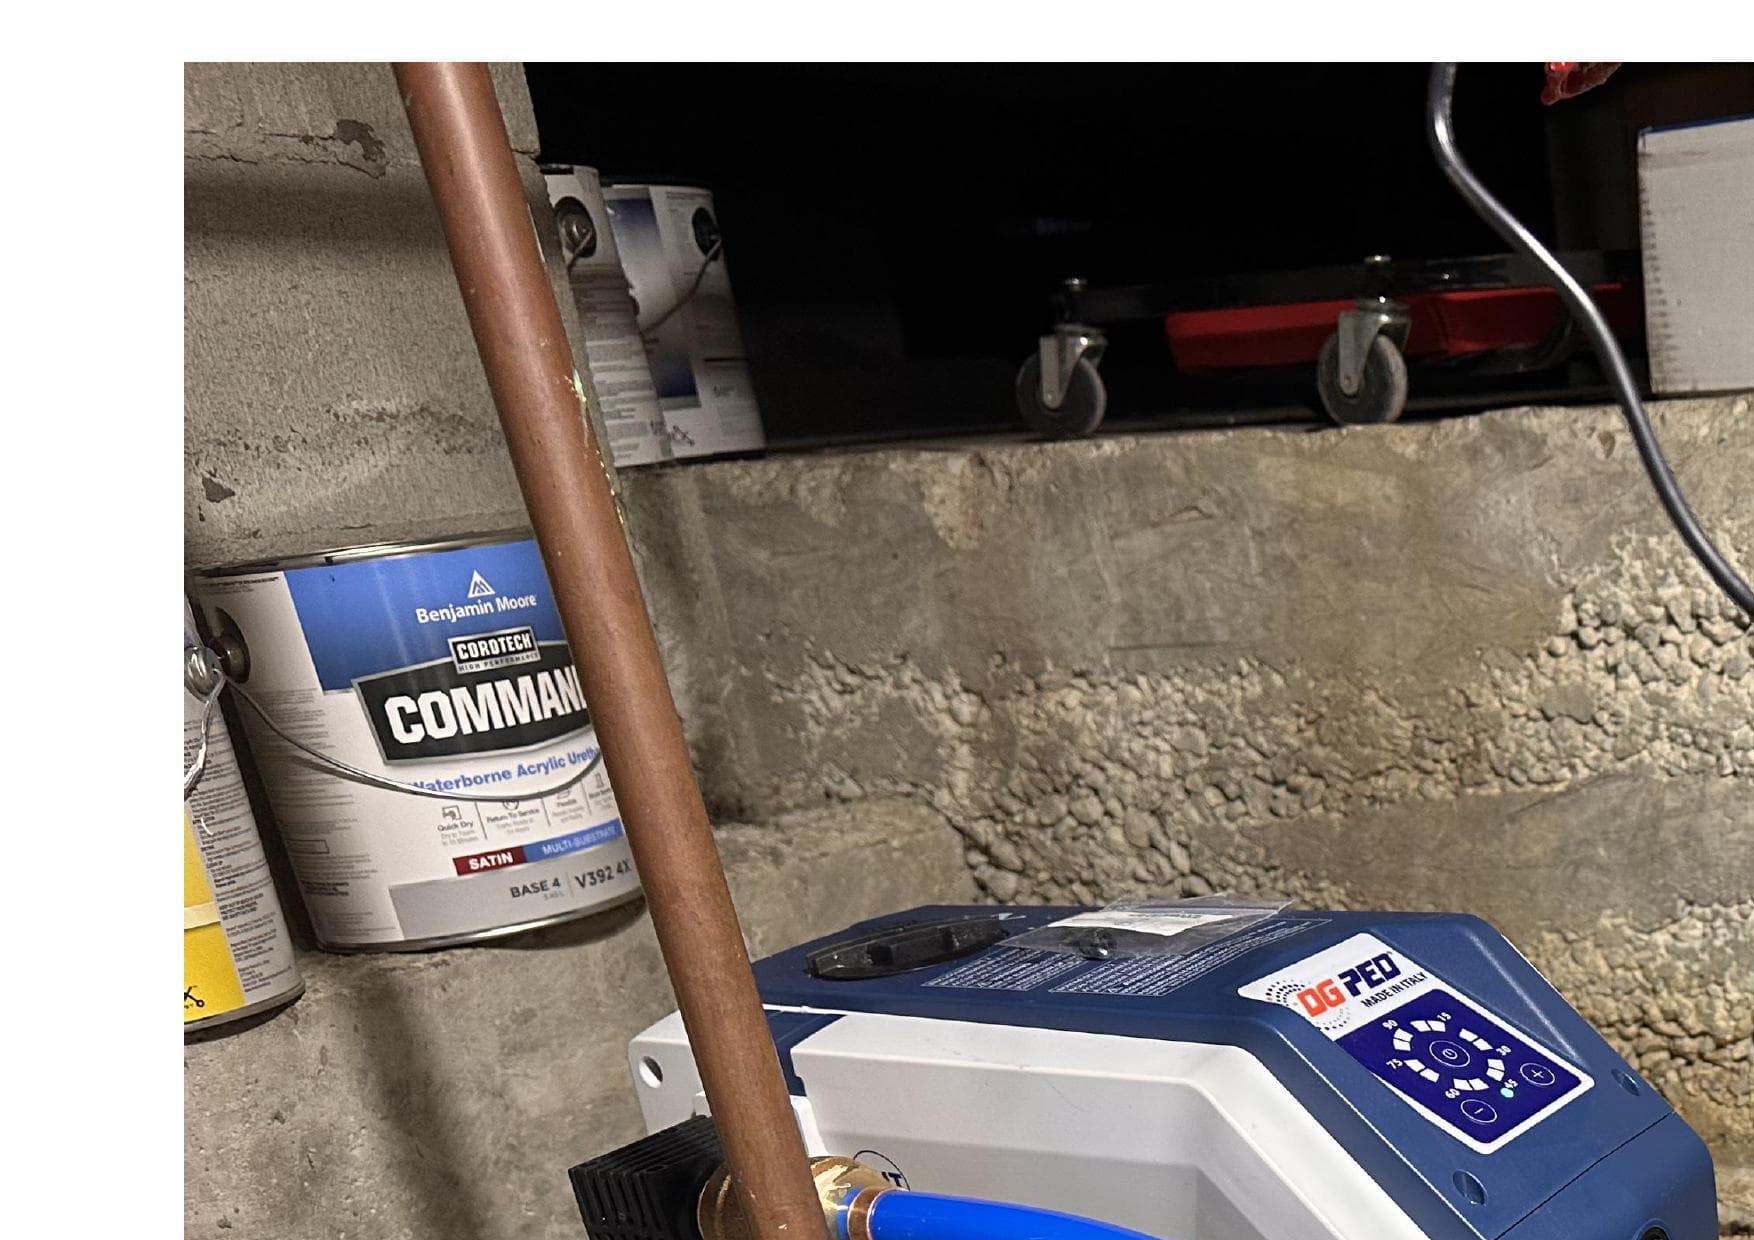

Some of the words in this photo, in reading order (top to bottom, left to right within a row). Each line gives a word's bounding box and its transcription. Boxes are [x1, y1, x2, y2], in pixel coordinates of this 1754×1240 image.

[416, 599, 494, 623] Benjamin
[496, 594, 536, 611] Moore
[456, 633, 531, 660] COROTECH
[458, 663, 481, 672] HIGH
[384, 665, 587, 744] COMMAN
[517, 755, 565, 777] Acrylic
[569, 746, 600, 765] Ureth
[437, 822, 458, 832] Quick
[460, 820, 474, 828] Dry
[542, 826, 616, 855] MULTI-SUBSTRATE
[469, 852, 514, 870] SATIN
[575, 865, 613, 889] V392
[616, 859, 632, 874] 4X
[510, 883, 548, 898] BASE
[552, 878, 560, 888] 4
[1338, 953, 1401, 997] PED
[1360, 989, 1393, 1008] MADE
[1388, 982, 1402, 994] IN
[1401, 972, 1428, 989] ITALY
[1382, 1019, 1398, 1030] 90
[1436, 1012, 1452, 1022] 15
[1496, 1045, 1512, 1056] 30
[1386, 1058, 1403, 1070] 75
[1445, 1088, 1460, 1099] 60
